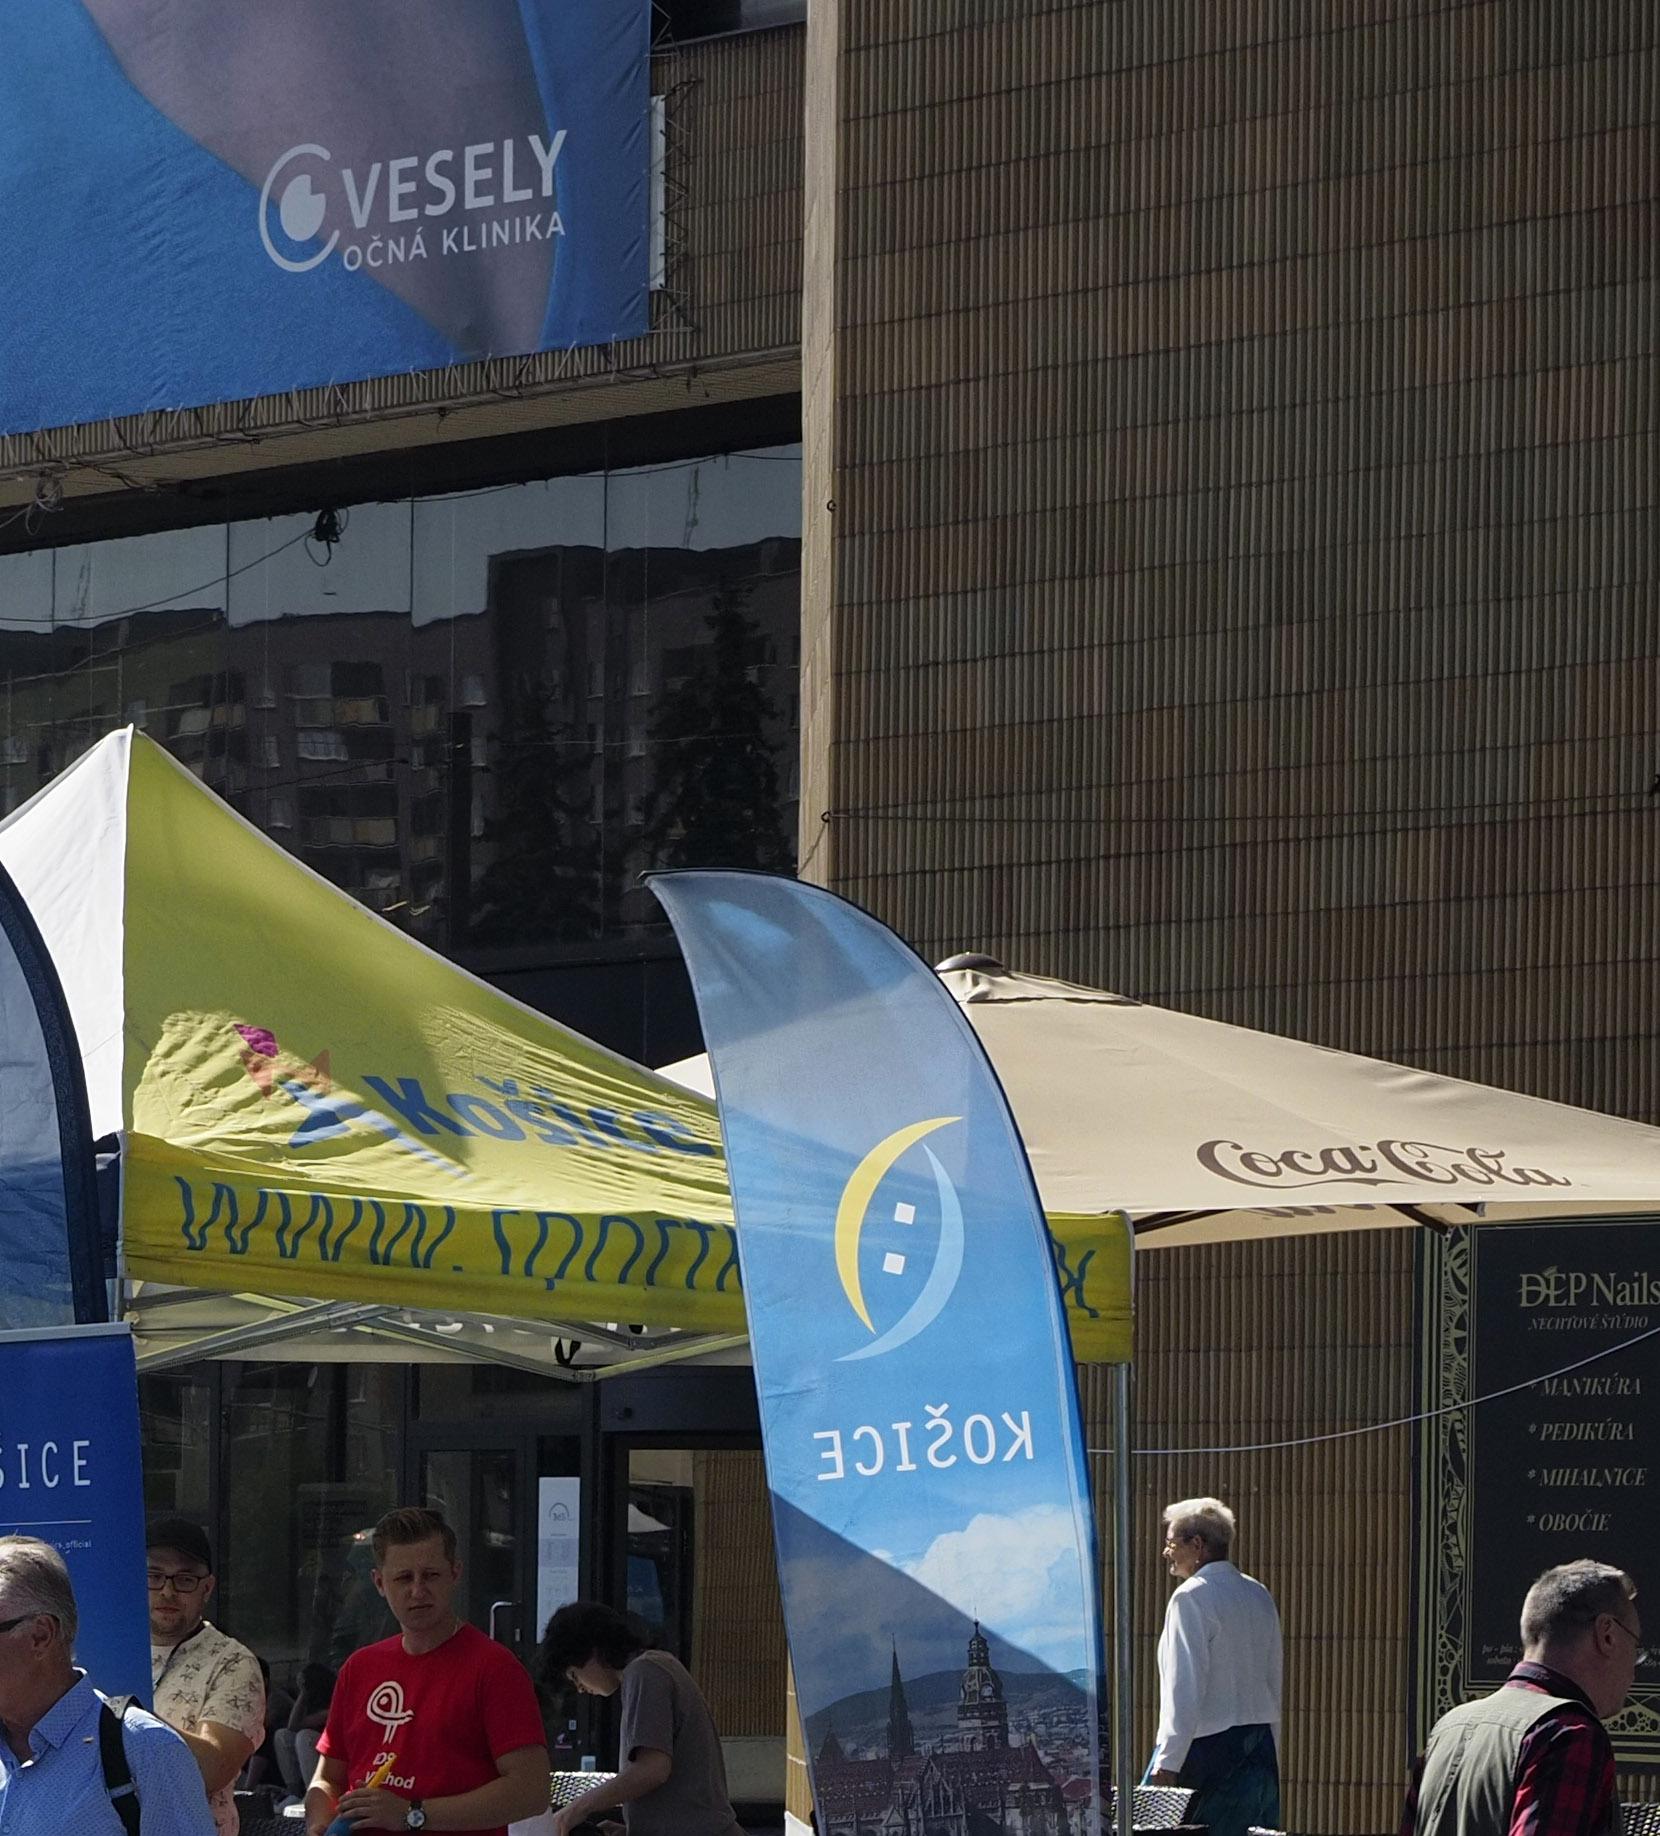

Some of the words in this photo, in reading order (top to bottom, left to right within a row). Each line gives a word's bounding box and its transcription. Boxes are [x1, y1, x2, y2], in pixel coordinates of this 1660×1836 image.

[341, 129, 569, 230] VESELY
[342, 225, 429, 272] OČNÁ
[440, 211, 567, 260] KLINIKA
[1196, 1139, 1571, 1188] Coca-Cola
[1591, 1271, 1660, 1306] Nails
[1542, 1373, 1641, 1397] MANIKÚRA
[1539, 1418, 1634, 1441] PEDIKÚRA
[1538, 1467, 1647, 1487] MIHALNICE
[1538, 1509, 1611, 1532] OBOČIE
